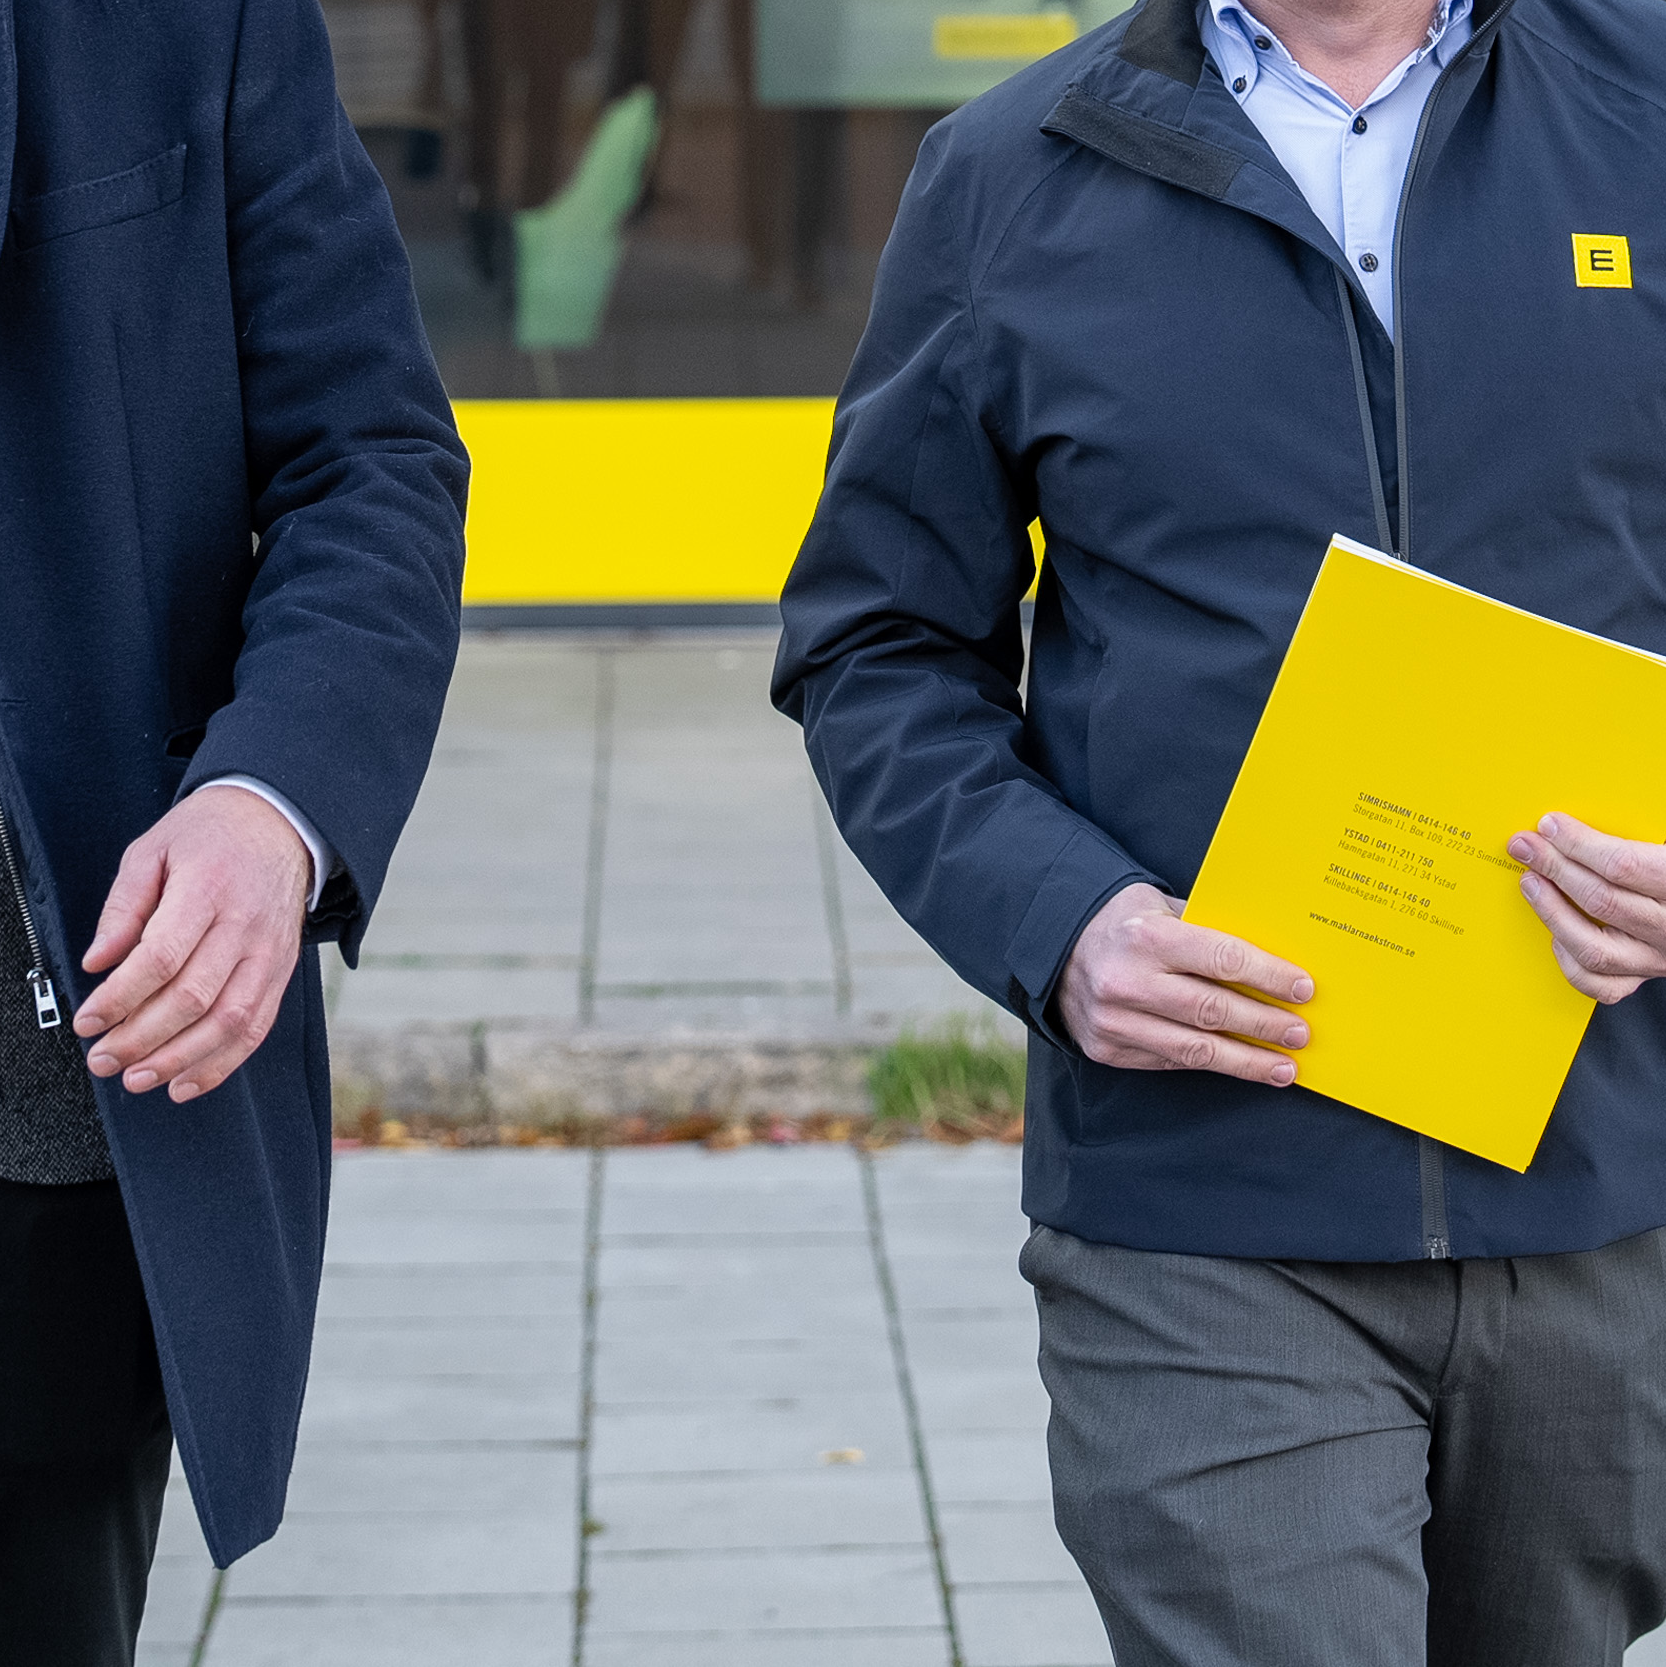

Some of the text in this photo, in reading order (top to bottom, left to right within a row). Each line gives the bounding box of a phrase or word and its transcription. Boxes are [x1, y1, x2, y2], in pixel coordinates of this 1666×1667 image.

[1590, 249, 1615, 272] E
[1352, 803, 1393, 825] Storgatan
[1409, 824, 1424, 838] Box
[1445, 838, 1463, 852] 272
[1463, 845, 1476, 856] 23
[1357, 791, 1412, 819] SIMRISHAMN
[1417, 814, 1459, 836] 0414-146
[1459, 830, 1472, 841] 40
[1337, 839, 1386, 864] Hamngatan
[1402, 863, 1418, 877] 271
[1419, 870, 1432, 881] 34
[1433, 874, 1458, 891] Ystad
[1344, 827, 1370, 844] YSTAD
[1375, 839, 1416, 861] 0411-211
[1417, 854, 1434, 868] 750
[1328, 862, 1372, 886] SKILLINGE
[1377, 881, 1419, 903] 0414-146
[1418, 897, 1431, 908] 40
[1309, 911, 1416, 958] www.maklarnaekstrom.se
[1399, 903, 1416, 917] 276
[1416, 910, 1429, 921] 60
[1429, 915, 1465, 936] Skillinge
